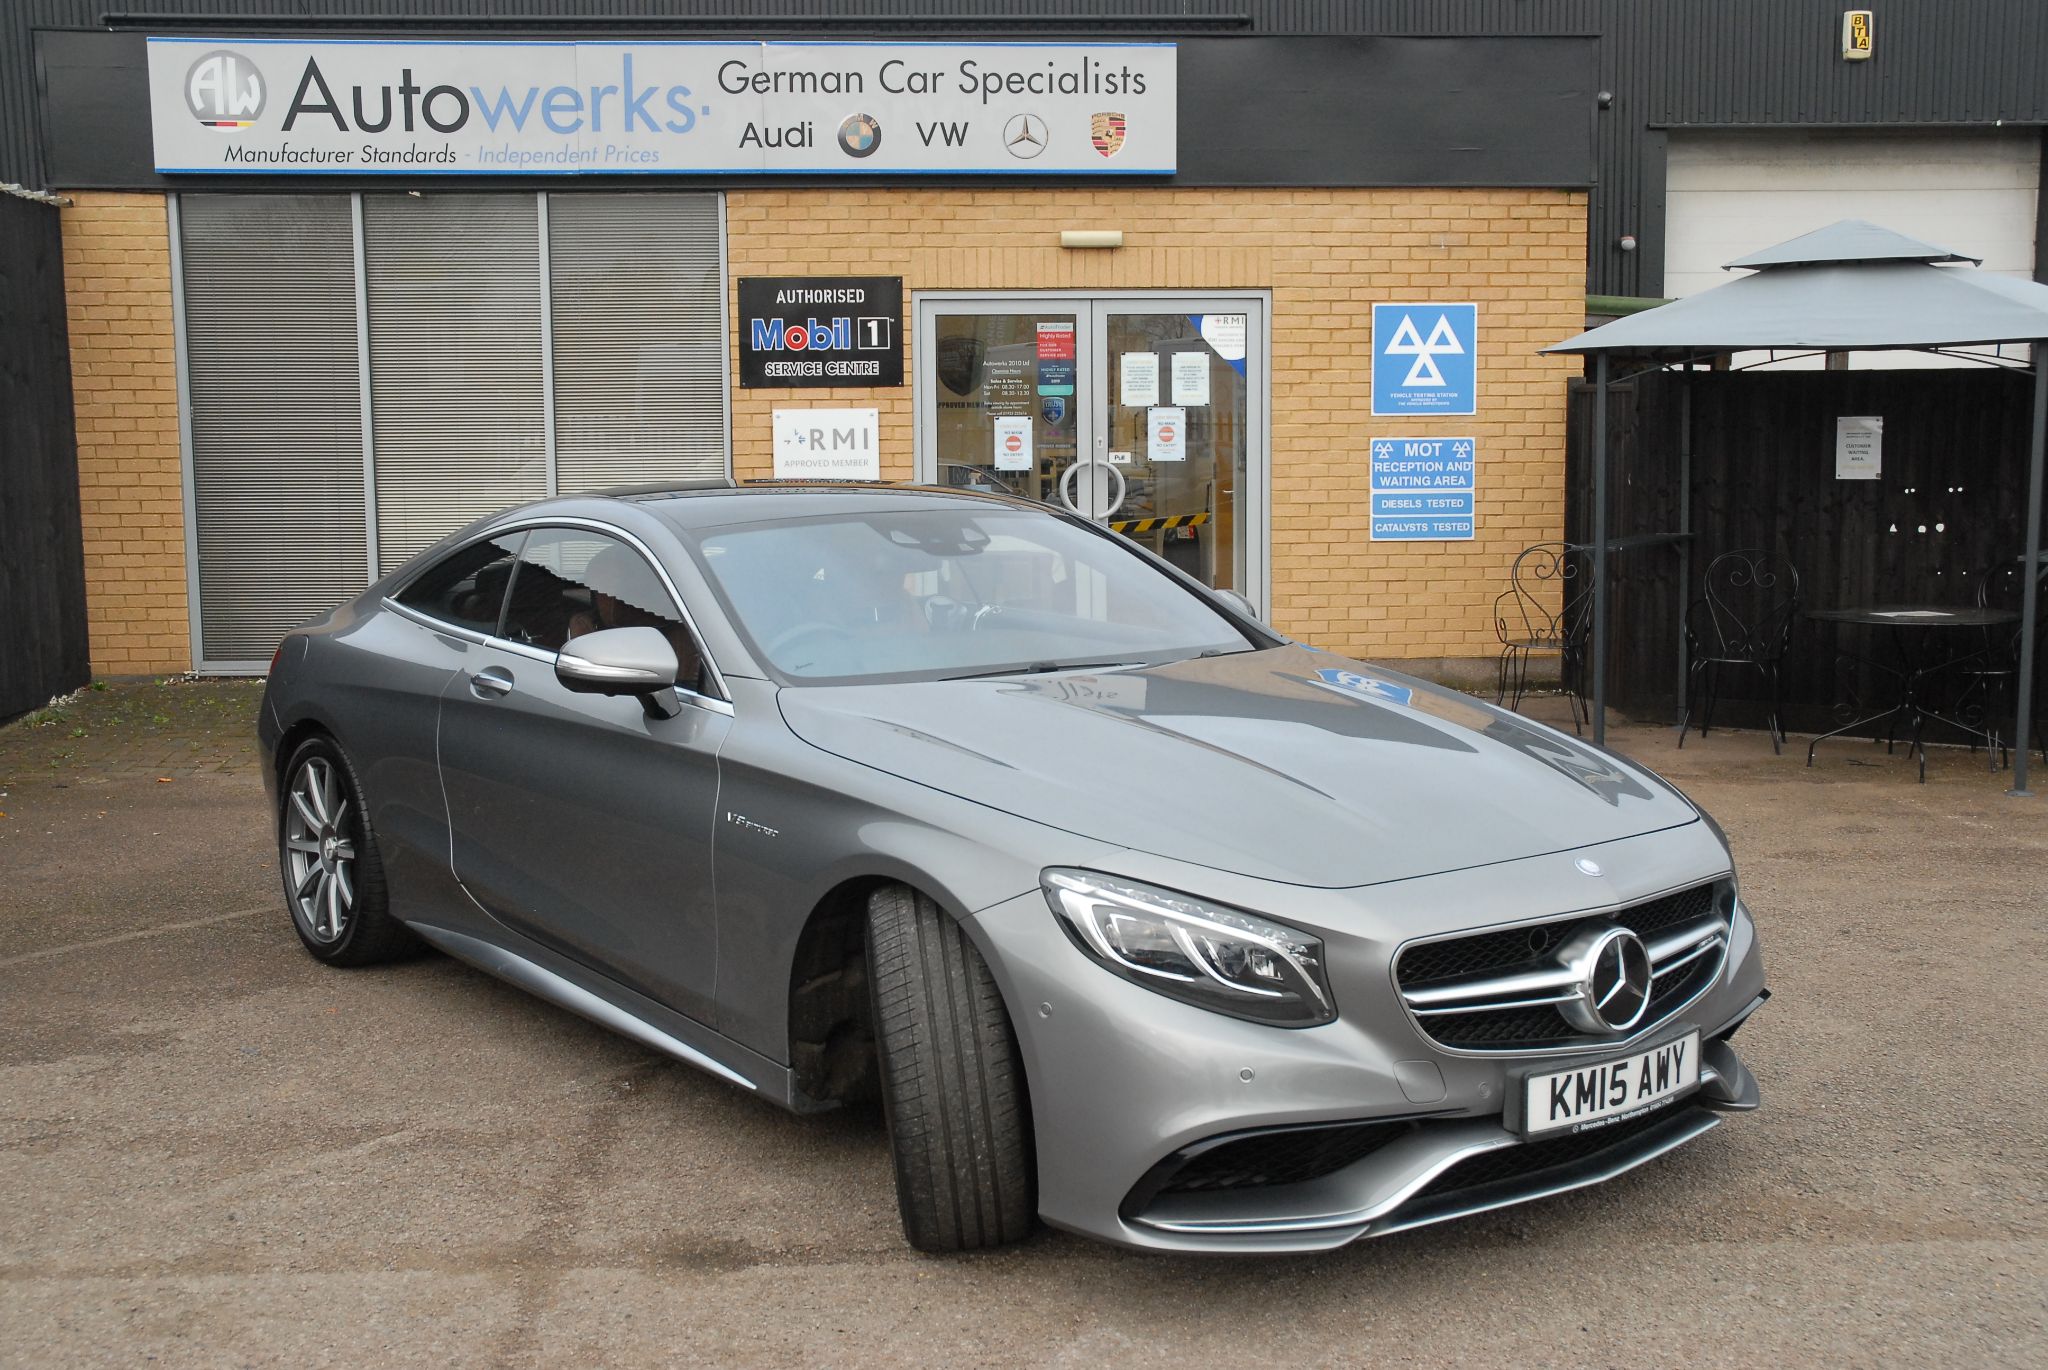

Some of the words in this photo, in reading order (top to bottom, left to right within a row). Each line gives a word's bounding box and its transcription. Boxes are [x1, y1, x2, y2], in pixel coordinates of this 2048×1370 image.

[717, 60, 864, 94] German
[879, 60, 945, 94] Car
[958, 56, 1147, 104] Specialists
[738, 122, 814, 148] Audi
[916, 122, 969, 147] VW
[224, 144, 354, 164] Manufacturer
[360, 143, 457, 164] Standards
[477, 144, 598, 169] Independent
[603, 144, 660, 164] Prices
[776, 289, 865, 304] AUTHORISED
[1223, 316, 1244, 324] RMI
[751, 317, 851, 351] Mobil
[765, 362, 823, 376] SERVICE
[825, 361, 880, 376] CENTRE
[809, 428, 870, 451] RMI
[1404, 443, 1442, 457] MOT
[784, 460, 830, 468] APPROVED
[832, 459, 869, 467] MEMBER
[1374, 462, 1443, 472] RECEPTION
[1446, 461, 1472, 471] AND
[1380, 476, 1431, 486] WAITING
[1434, 476, 1466, 486] AREA
[1381, 499, 1422, 509] DIESELS
[1426, 499, 1464, 508] TESTED
[1375, 523, 1429, 532] CATALYSTS
[1433, 522, 1470, 531] TESTED
[1550, 1061, 1628, 1121] KM15
[1637, 1041, 1685, 1099] AWY
